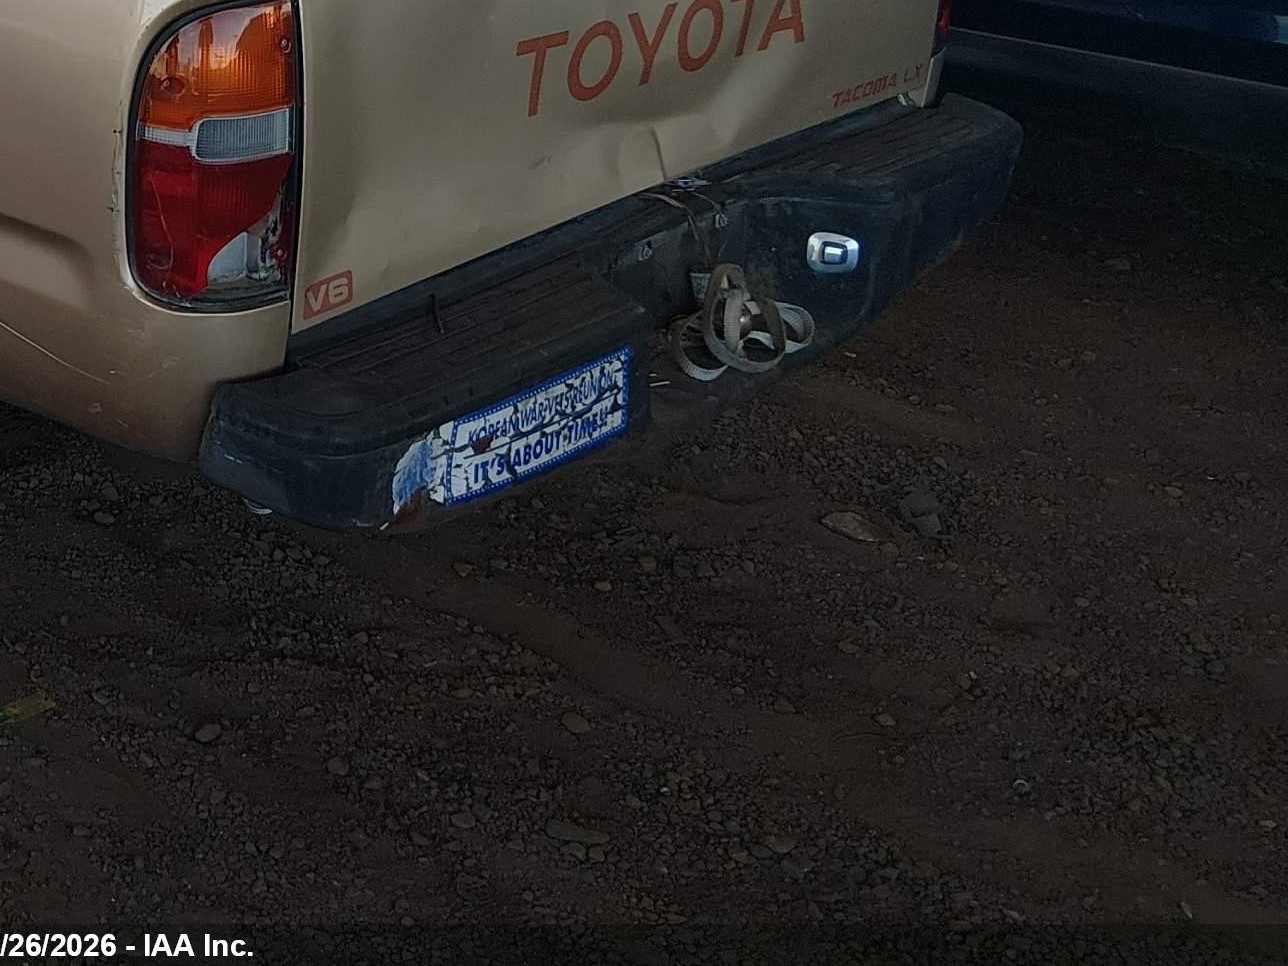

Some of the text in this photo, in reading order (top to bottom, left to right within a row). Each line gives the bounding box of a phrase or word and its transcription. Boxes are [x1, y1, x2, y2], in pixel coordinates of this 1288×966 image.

[832, 73, 897, 108] TACOMA
[306, 277, 349, 312] V6
[474, 456, 506, 485] IT'S
[512, 430, 563, 468] ABOUT
